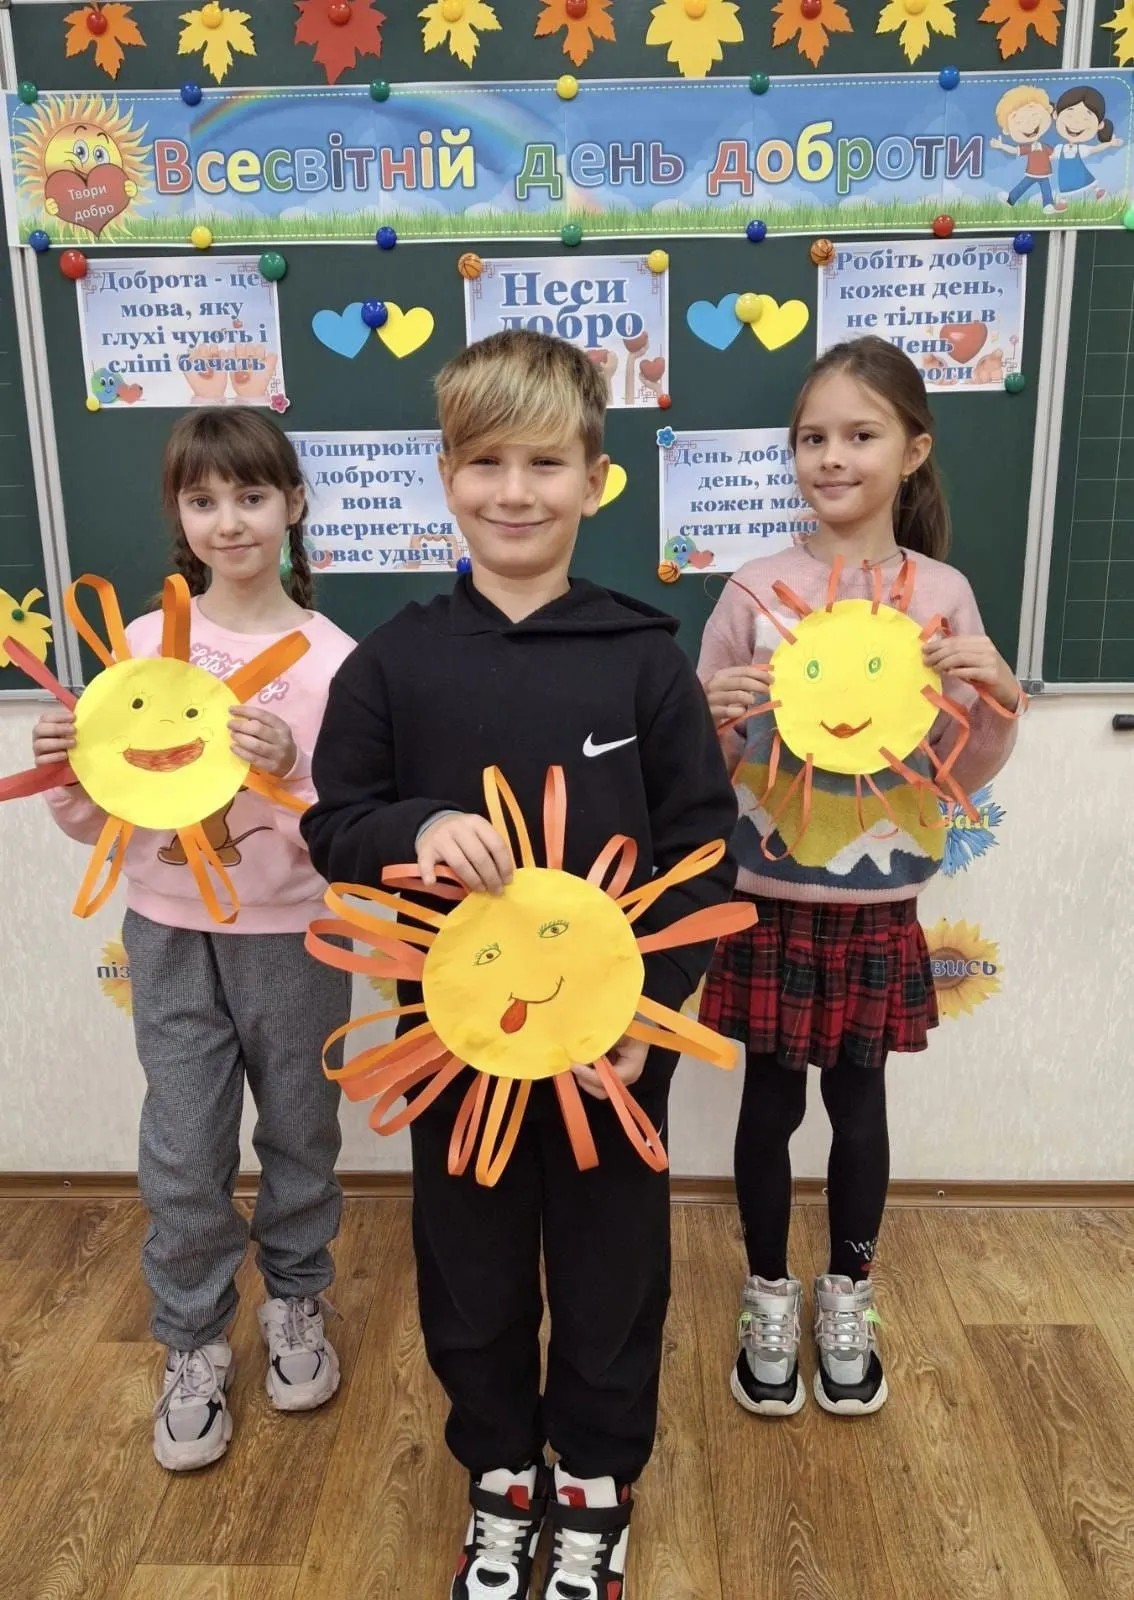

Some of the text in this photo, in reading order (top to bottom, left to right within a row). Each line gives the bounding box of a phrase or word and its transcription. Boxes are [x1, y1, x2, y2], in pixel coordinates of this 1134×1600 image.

[153, 119, 985, 200] Всесвітній день доброти
[68, 184, 108, 200] Твори
[75, 204, 115, 222] добро
[837, 247, 1010, 271] Робіть добро
[100, 270, 208, 294] Доброта
[230, 273, 259, 289] це
[500, 272, 628, 307] Неси
[840, 281, 1004, 300] кожен день,
[121, 302, 244, 319] мова, яку
[847, 306, 996, 328] не тільки в
[101, 324, 268, 349] глухі чують і
[108, 353, 266, 373] сліпі бачать
[674, 444, 795, 467] День добр
[315, 466, 424, 488] доброту,
[698, 472, 799, 491] день, ко
[341, 496, 403, 511] вона
[690, 498, 763, 512] кожен
[680, 522, 741, 537] стати
[333, 549, 375, 562] вас
[380, 543, 454, 566] удвічі
[97, 961, 131, 978] піз
[930, 959, 997, 977] вись
